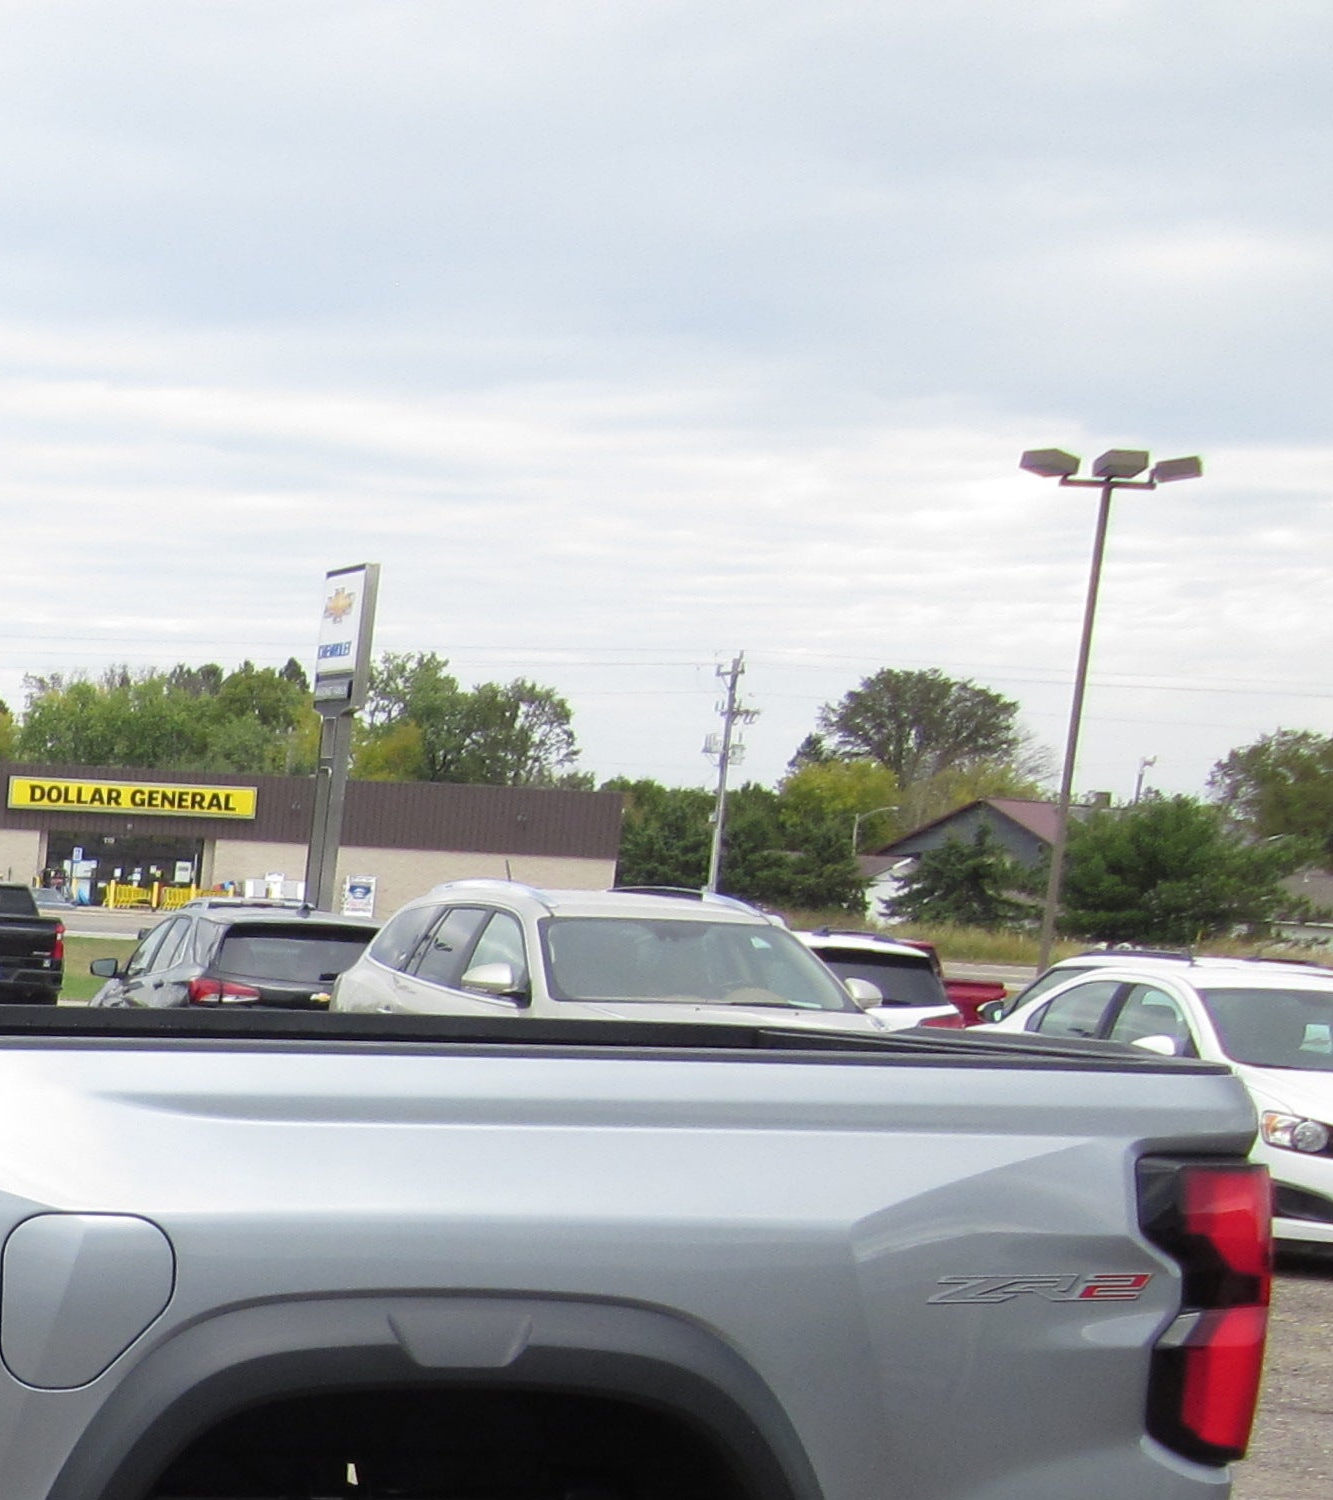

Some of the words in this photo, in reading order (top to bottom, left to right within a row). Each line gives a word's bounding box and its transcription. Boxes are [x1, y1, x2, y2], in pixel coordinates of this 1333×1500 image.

[29, 784, 122, 806] DOLLAR
[130, 789, 236, 812] GENERAL
[926, 1272, 1155, 1305] ZR2
